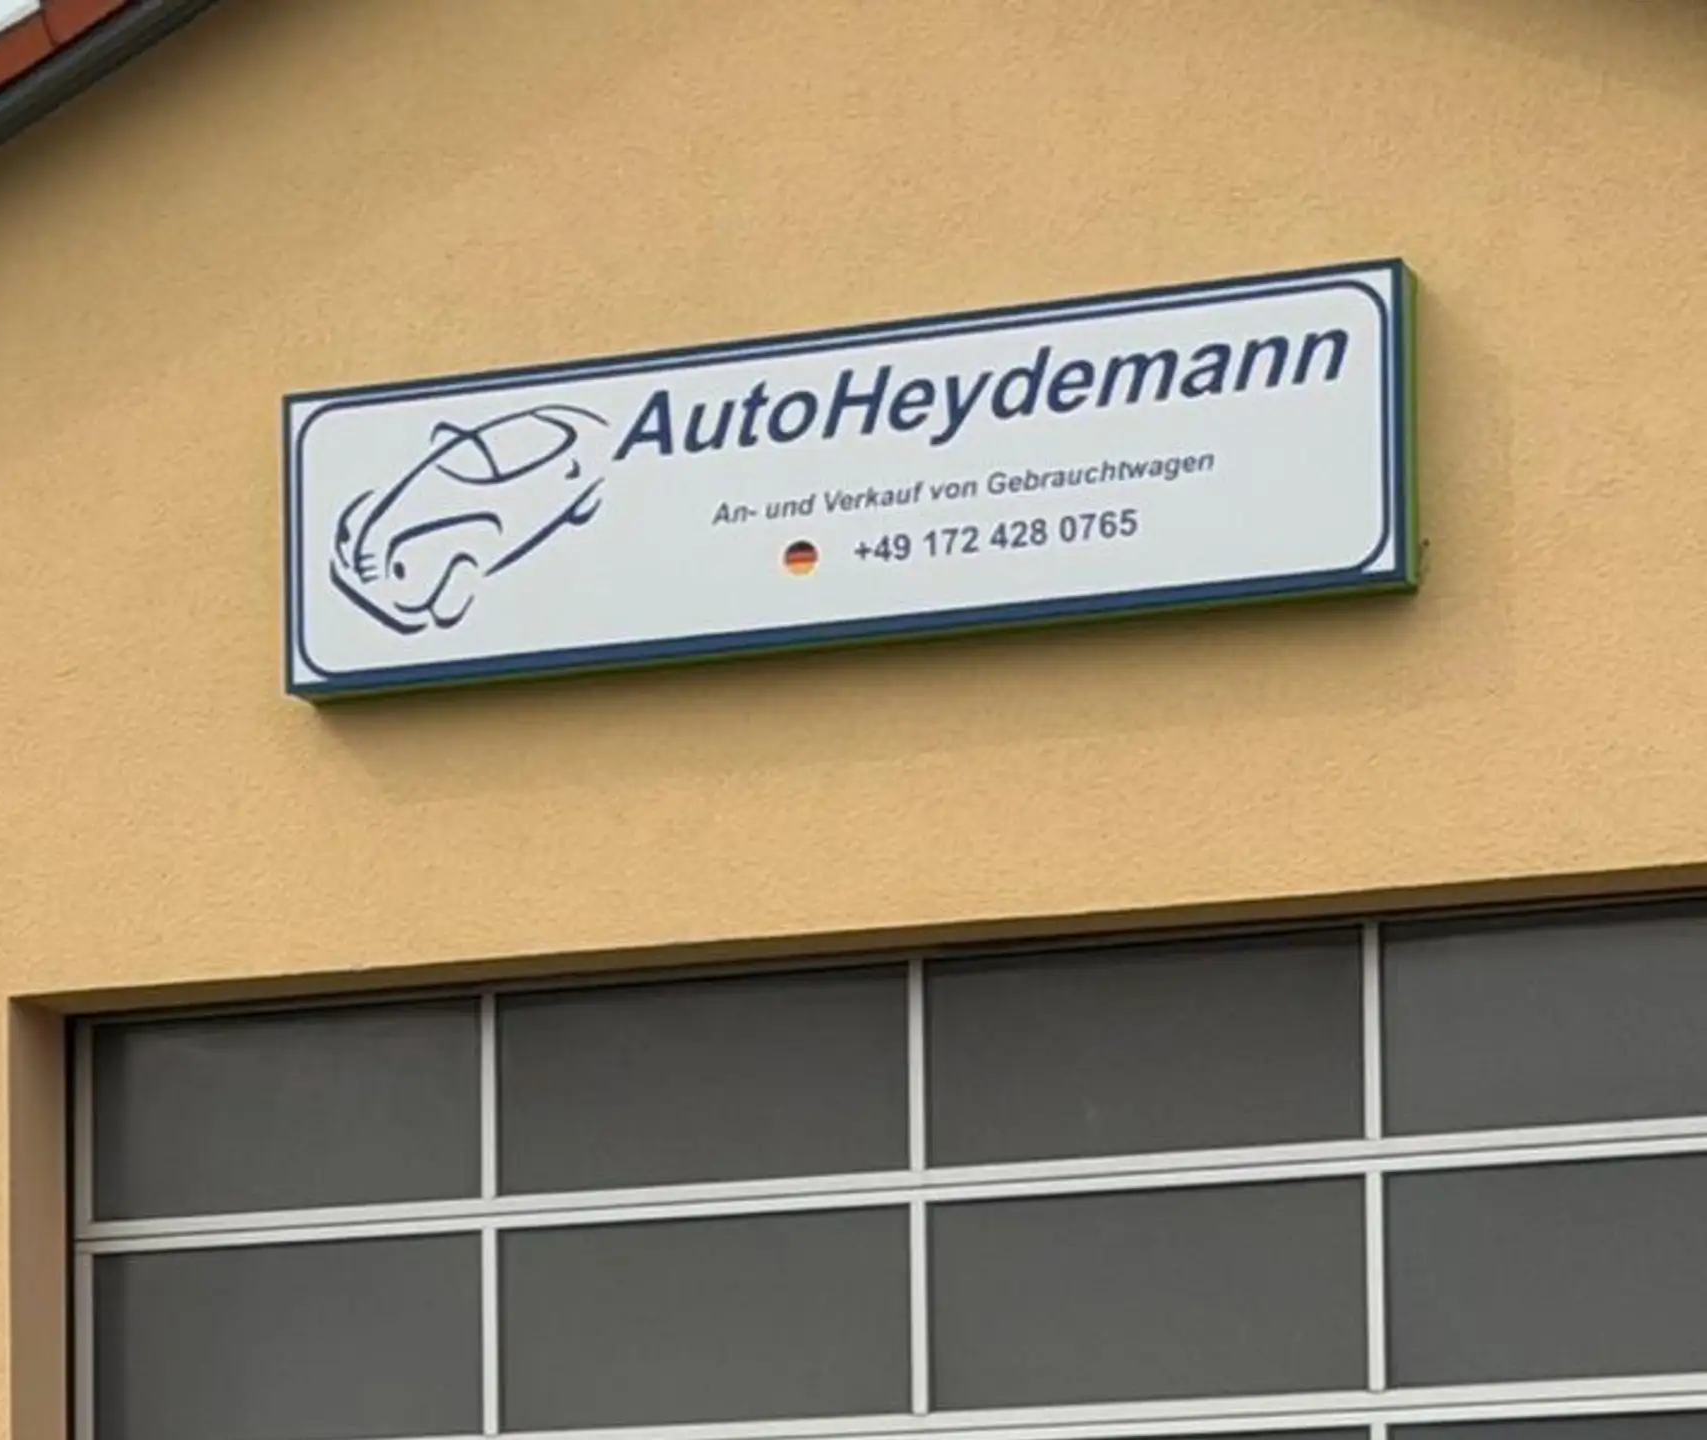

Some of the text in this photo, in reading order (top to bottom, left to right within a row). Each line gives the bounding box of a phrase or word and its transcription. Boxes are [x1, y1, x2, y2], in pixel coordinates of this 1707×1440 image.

[612, 328, 1350, 462] AutoHeydemann
[712, 452, 1215, 525] An- und Verkauf von Gebrauchtwagen
[854, 508, 1139, 561] +49 172 428 0765
